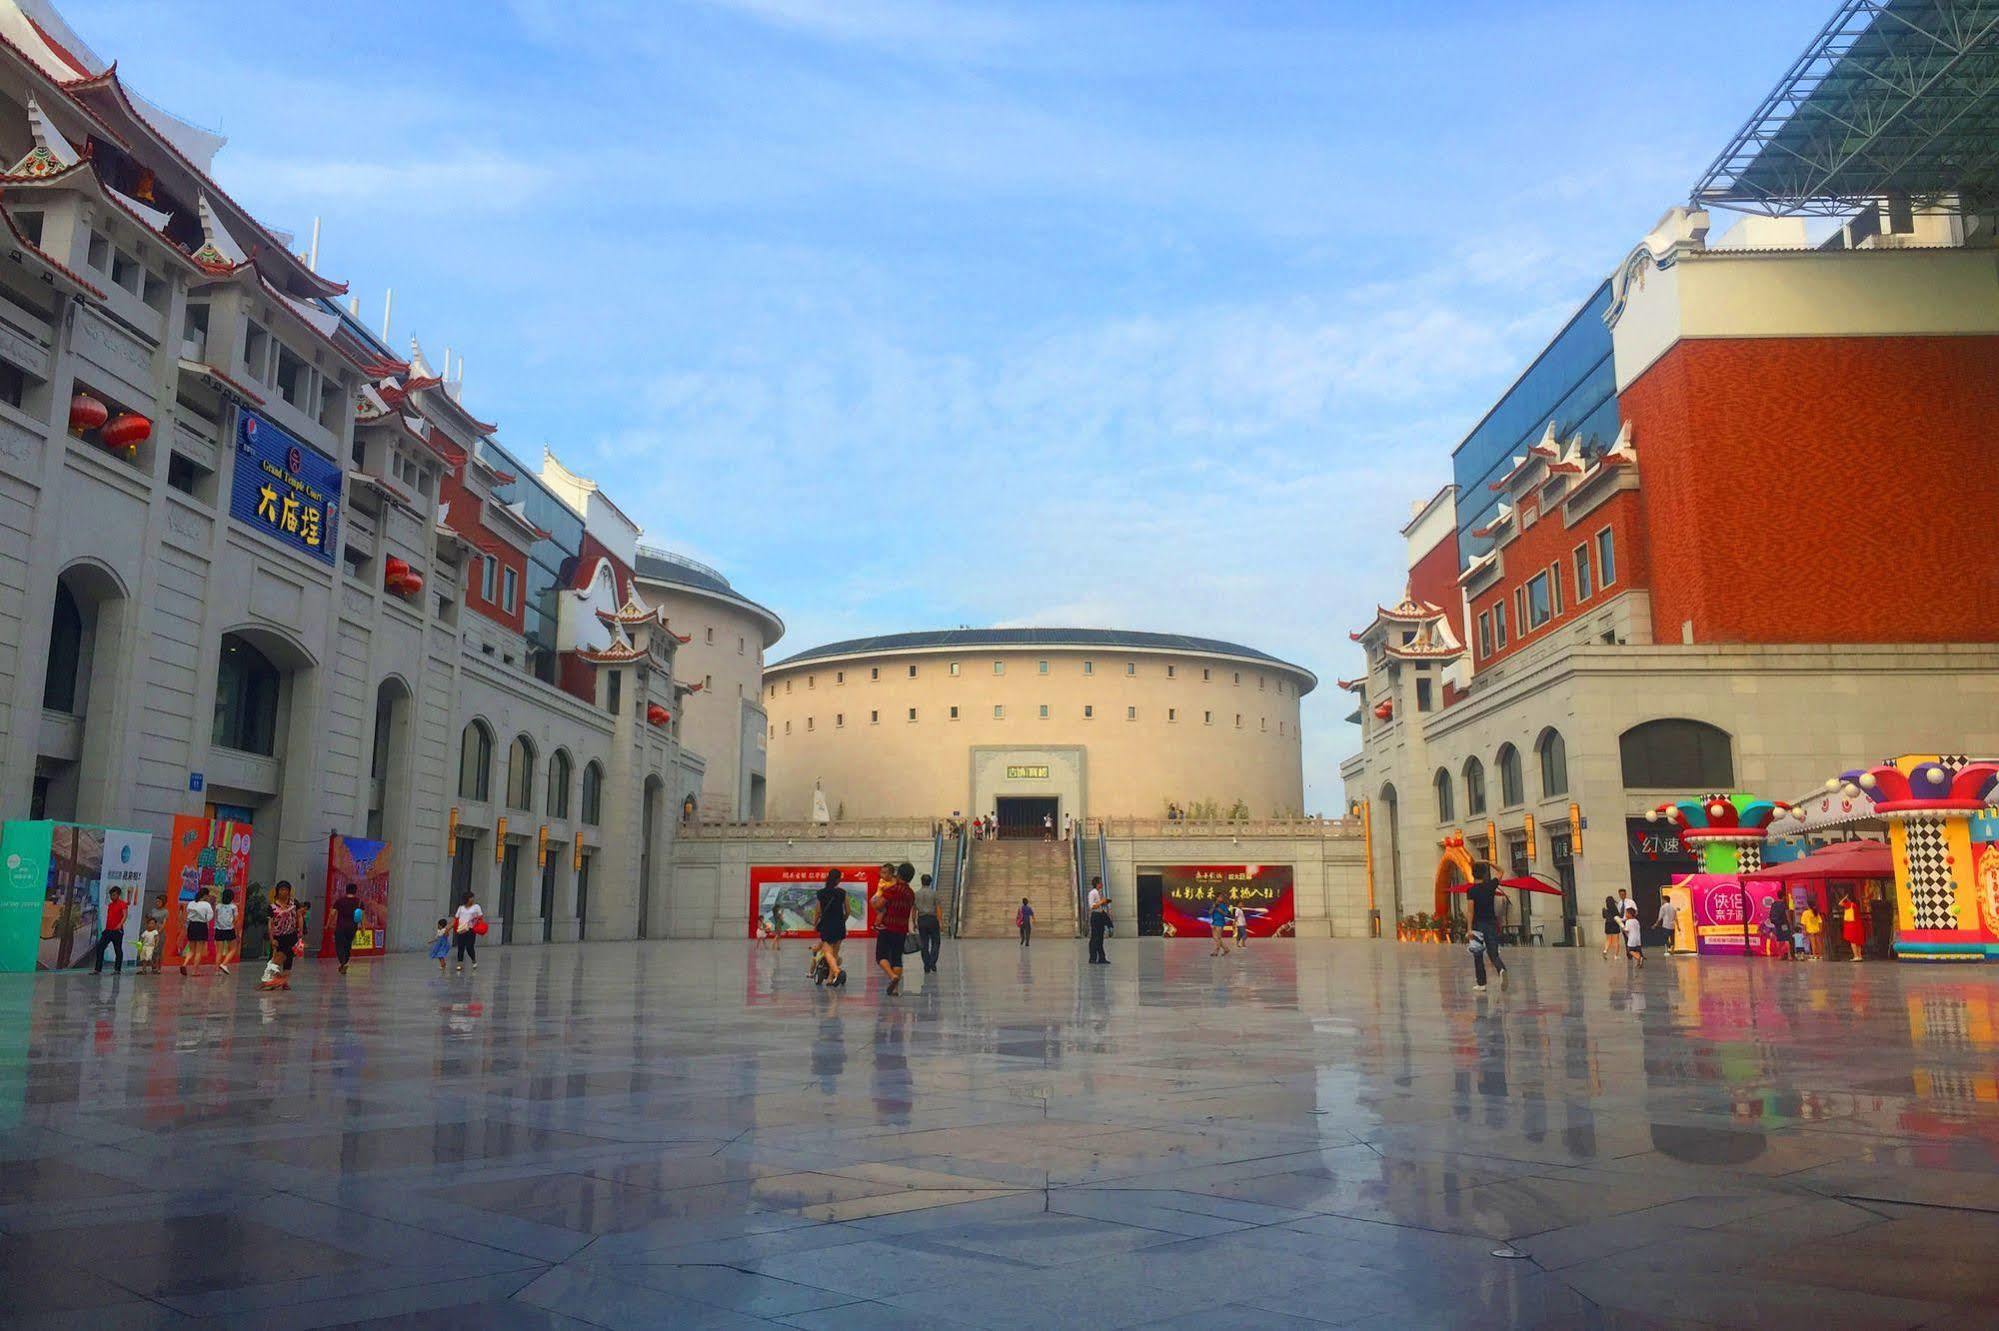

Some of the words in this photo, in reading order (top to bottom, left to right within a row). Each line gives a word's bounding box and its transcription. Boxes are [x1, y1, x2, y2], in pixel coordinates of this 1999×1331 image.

[262, 459, 282, 480] Grand
[284, 471, 305, 493] Temple
[306, 485, 323, 502] Court
[258, 483, 321, 546] 大庙埕
